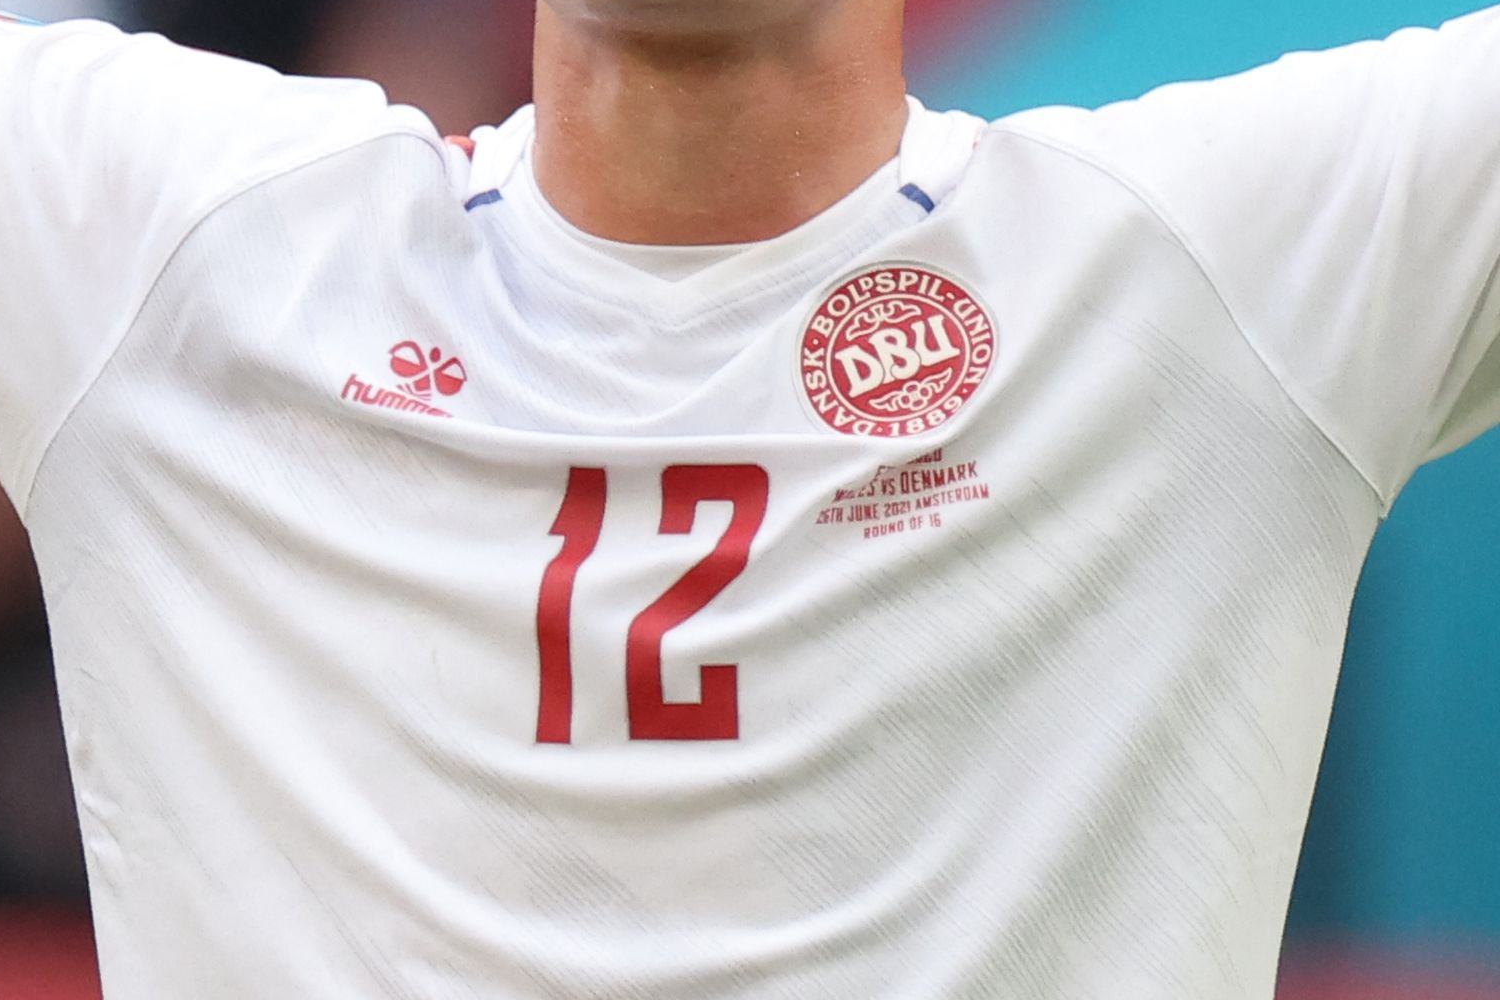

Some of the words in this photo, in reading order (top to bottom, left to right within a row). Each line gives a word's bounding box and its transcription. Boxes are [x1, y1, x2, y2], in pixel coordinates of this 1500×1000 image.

[835, 314, 960, 398] DBU
[889, 395, 963, 436] 1889
[881, 477, 896, 495] VS
[900, 460, 979, 495] DENMARK
[847, 503, 880, 522] JUNE
[884, 501, 913, 518] 2021
[915, 483, 990, 510] AMSTERDAM
[863, 520, 905, 539] ROUND
[909, 517, 924, 531] OF
[930, 513, 942, 528] 16
[535, 463, 769, 744] 12
